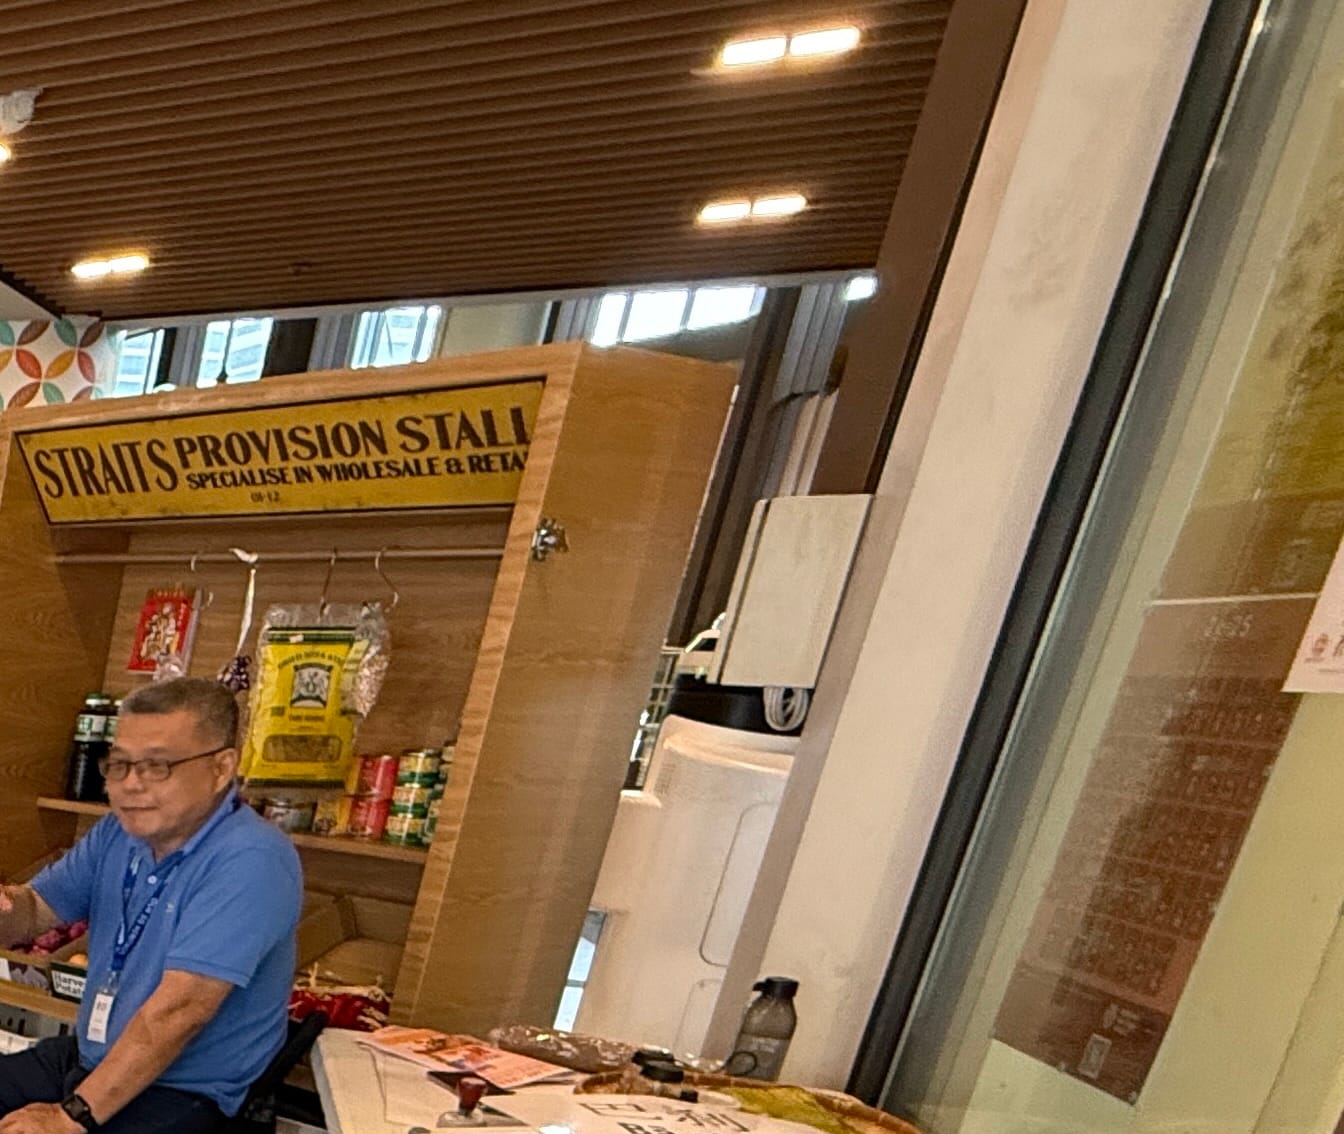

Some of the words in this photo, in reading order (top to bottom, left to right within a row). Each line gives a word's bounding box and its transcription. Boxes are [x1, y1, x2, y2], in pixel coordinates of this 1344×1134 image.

[35, 438, 178, 499] STRAITS
[173, 418, 388, 469] PROVISION
[396, 406, 531, 454] STALL
[186, 466, 292, 490] SPECIALISE
[295, 465, 313, 484] IN
[317, 456, 442, 481] WHOLESALE
[445, 456, 463, 475] &
